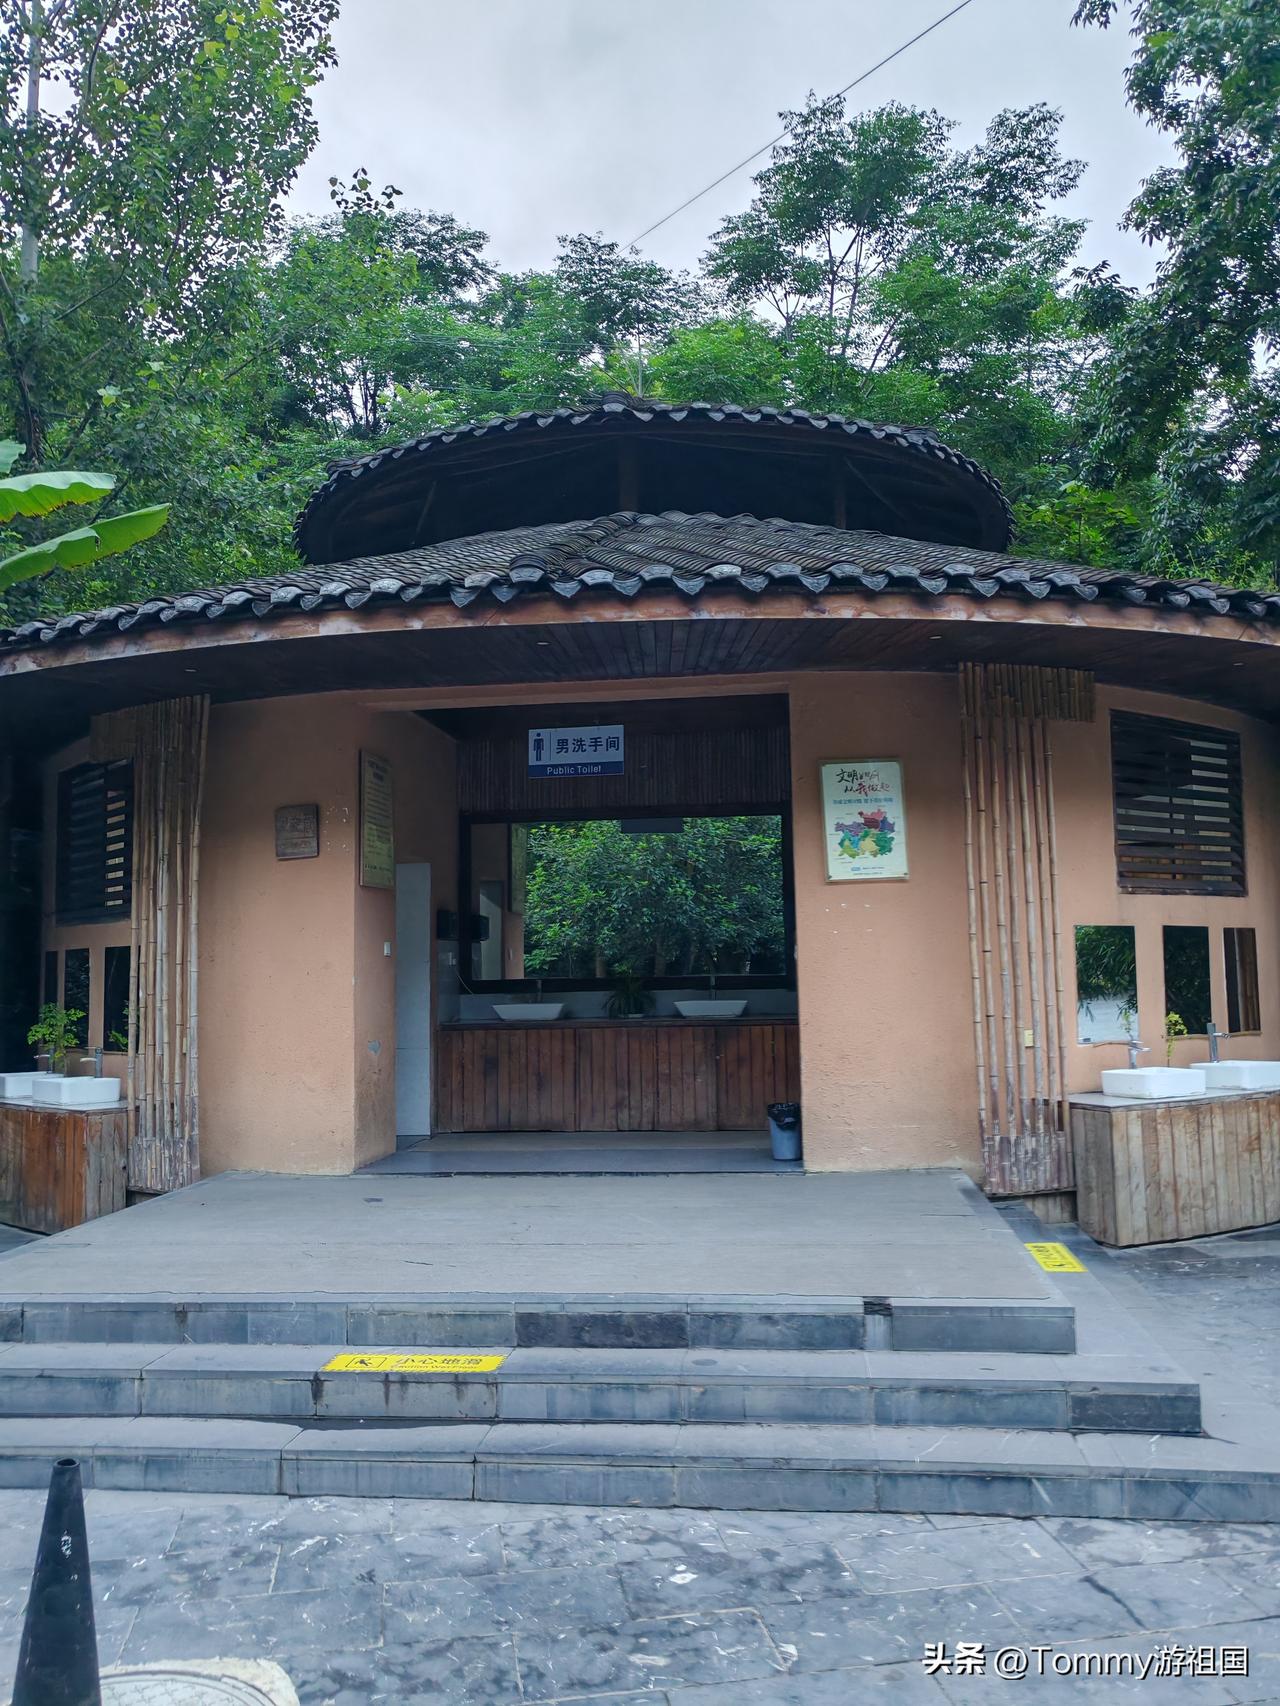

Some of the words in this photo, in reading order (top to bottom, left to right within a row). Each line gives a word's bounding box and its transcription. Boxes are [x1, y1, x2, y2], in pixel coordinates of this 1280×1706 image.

[556, 736, 620, 754] 男洗手间
[547, 766, 575, 775] Public
[577, 765, 601, 774] Toilet
[396, 1357, 483, 1365] 小心地滑
